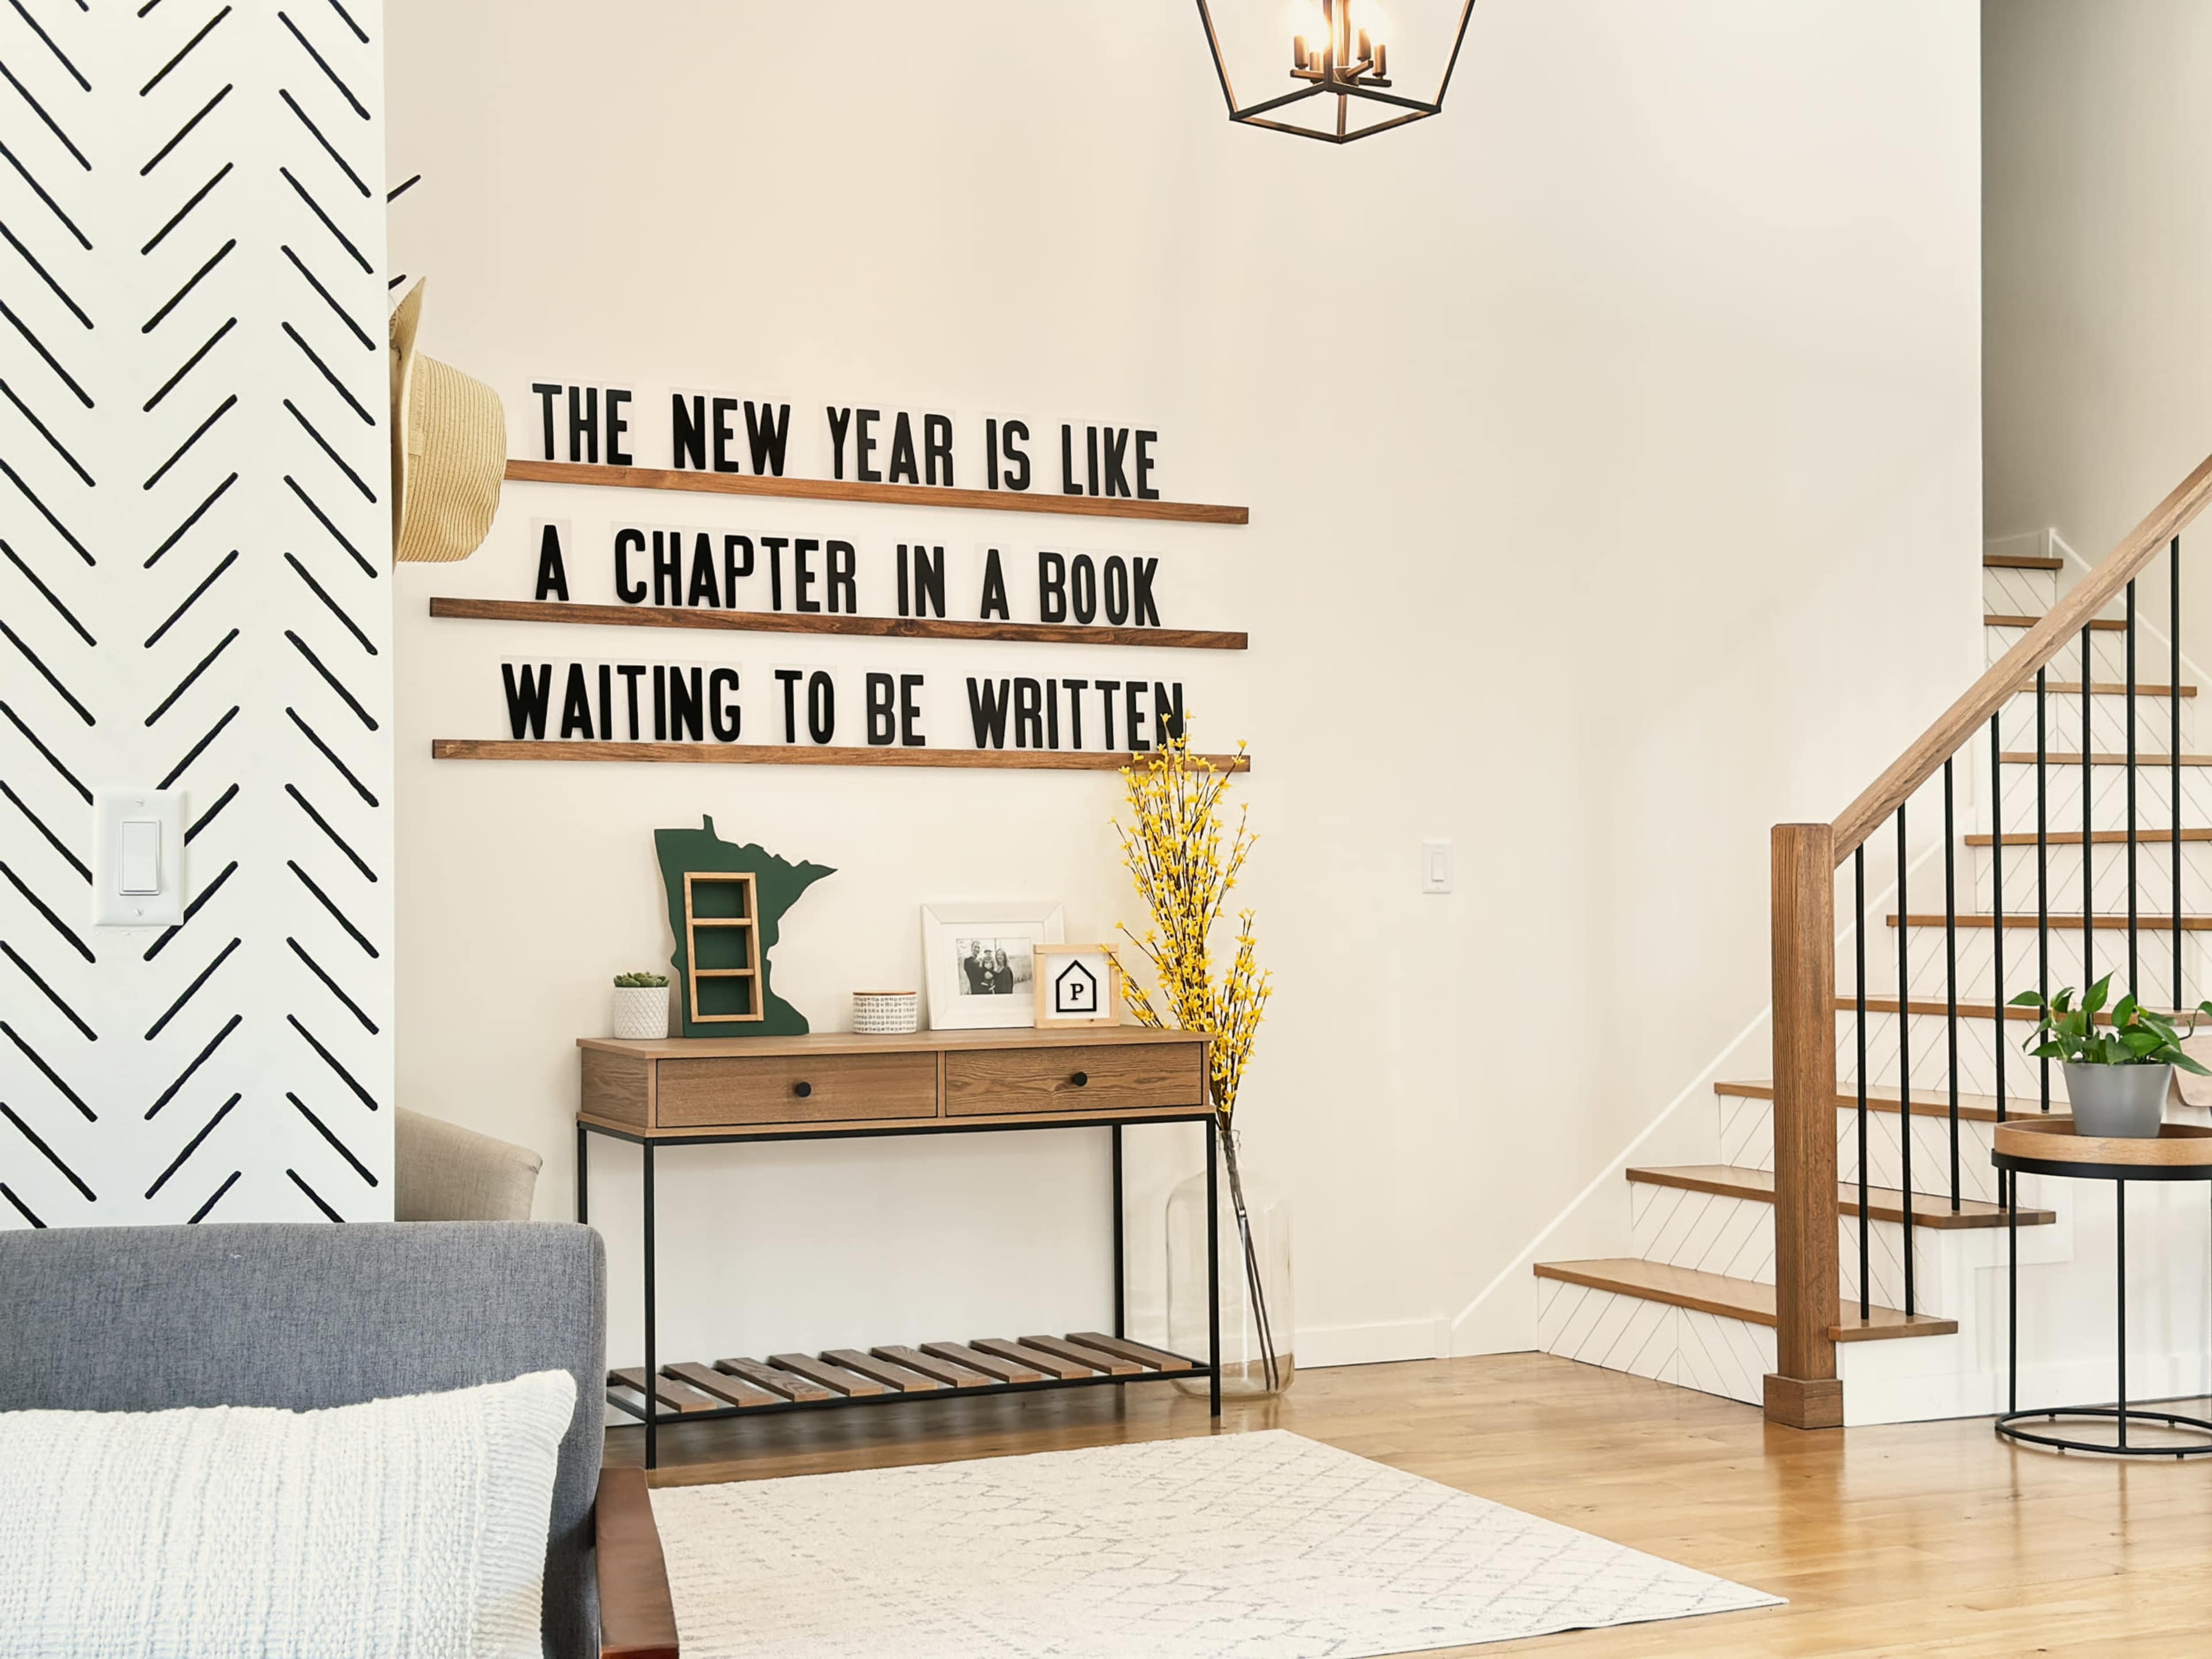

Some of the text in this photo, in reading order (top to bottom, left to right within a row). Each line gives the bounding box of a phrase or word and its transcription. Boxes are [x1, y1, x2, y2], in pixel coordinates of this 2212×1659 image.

[532, 383, 1159, 500] THE NEW YEAR IS LIKE
[535, 525, 1161, 627] A CHAPTER IN A BOOK
[501, 663, 1184, 751] WAITING TO BE WRITTEN
[1070, 983, 1084, 1001] P
